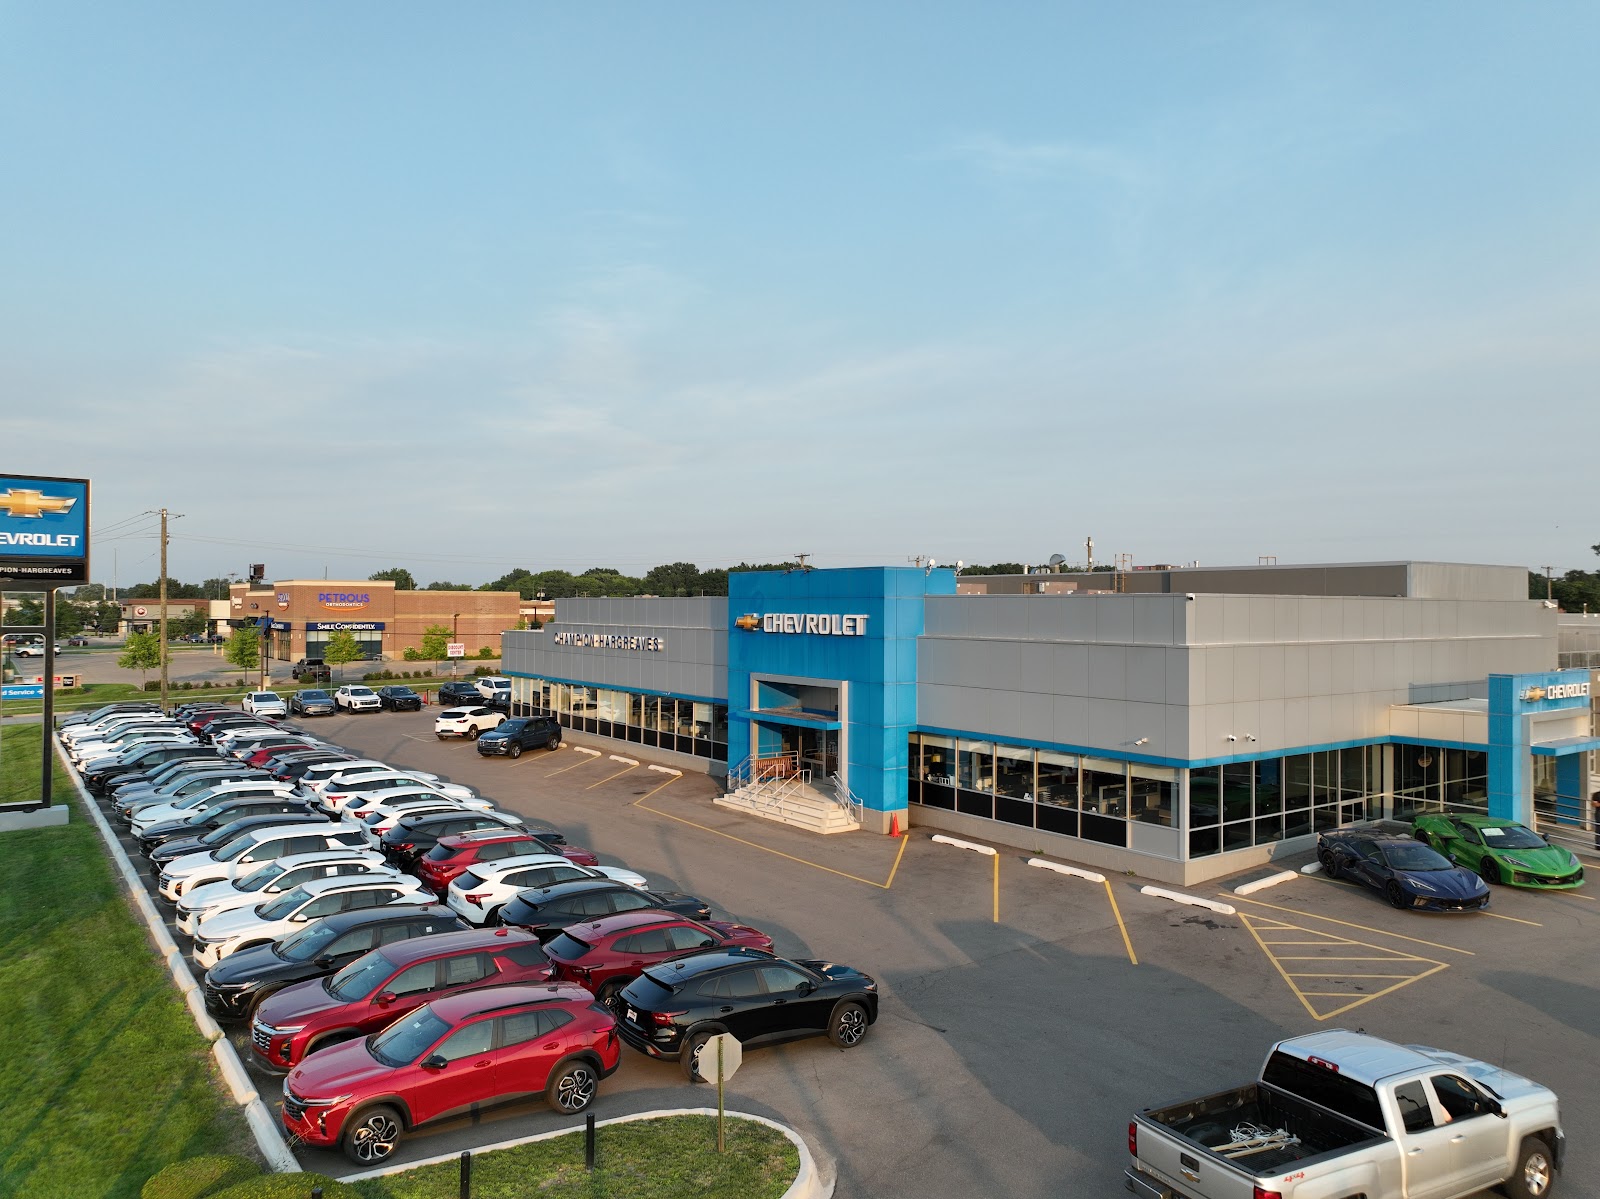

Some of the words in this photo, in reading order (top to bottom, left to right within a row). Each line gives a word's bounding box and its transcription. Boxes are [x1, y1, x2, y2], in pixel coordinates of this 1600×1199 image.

[0, 532, 79, 547] EVROLET
[0, 566, 72, 575] PION-HARGREAVES
[318, 593, 370, 603] PETROUS
[763, 613, 870, 636] CHEVROLET
[554, 632, 662, 652] CHAMPION-HARGREAVES
[1547, 682, 1591, 700] CHEVROLET
